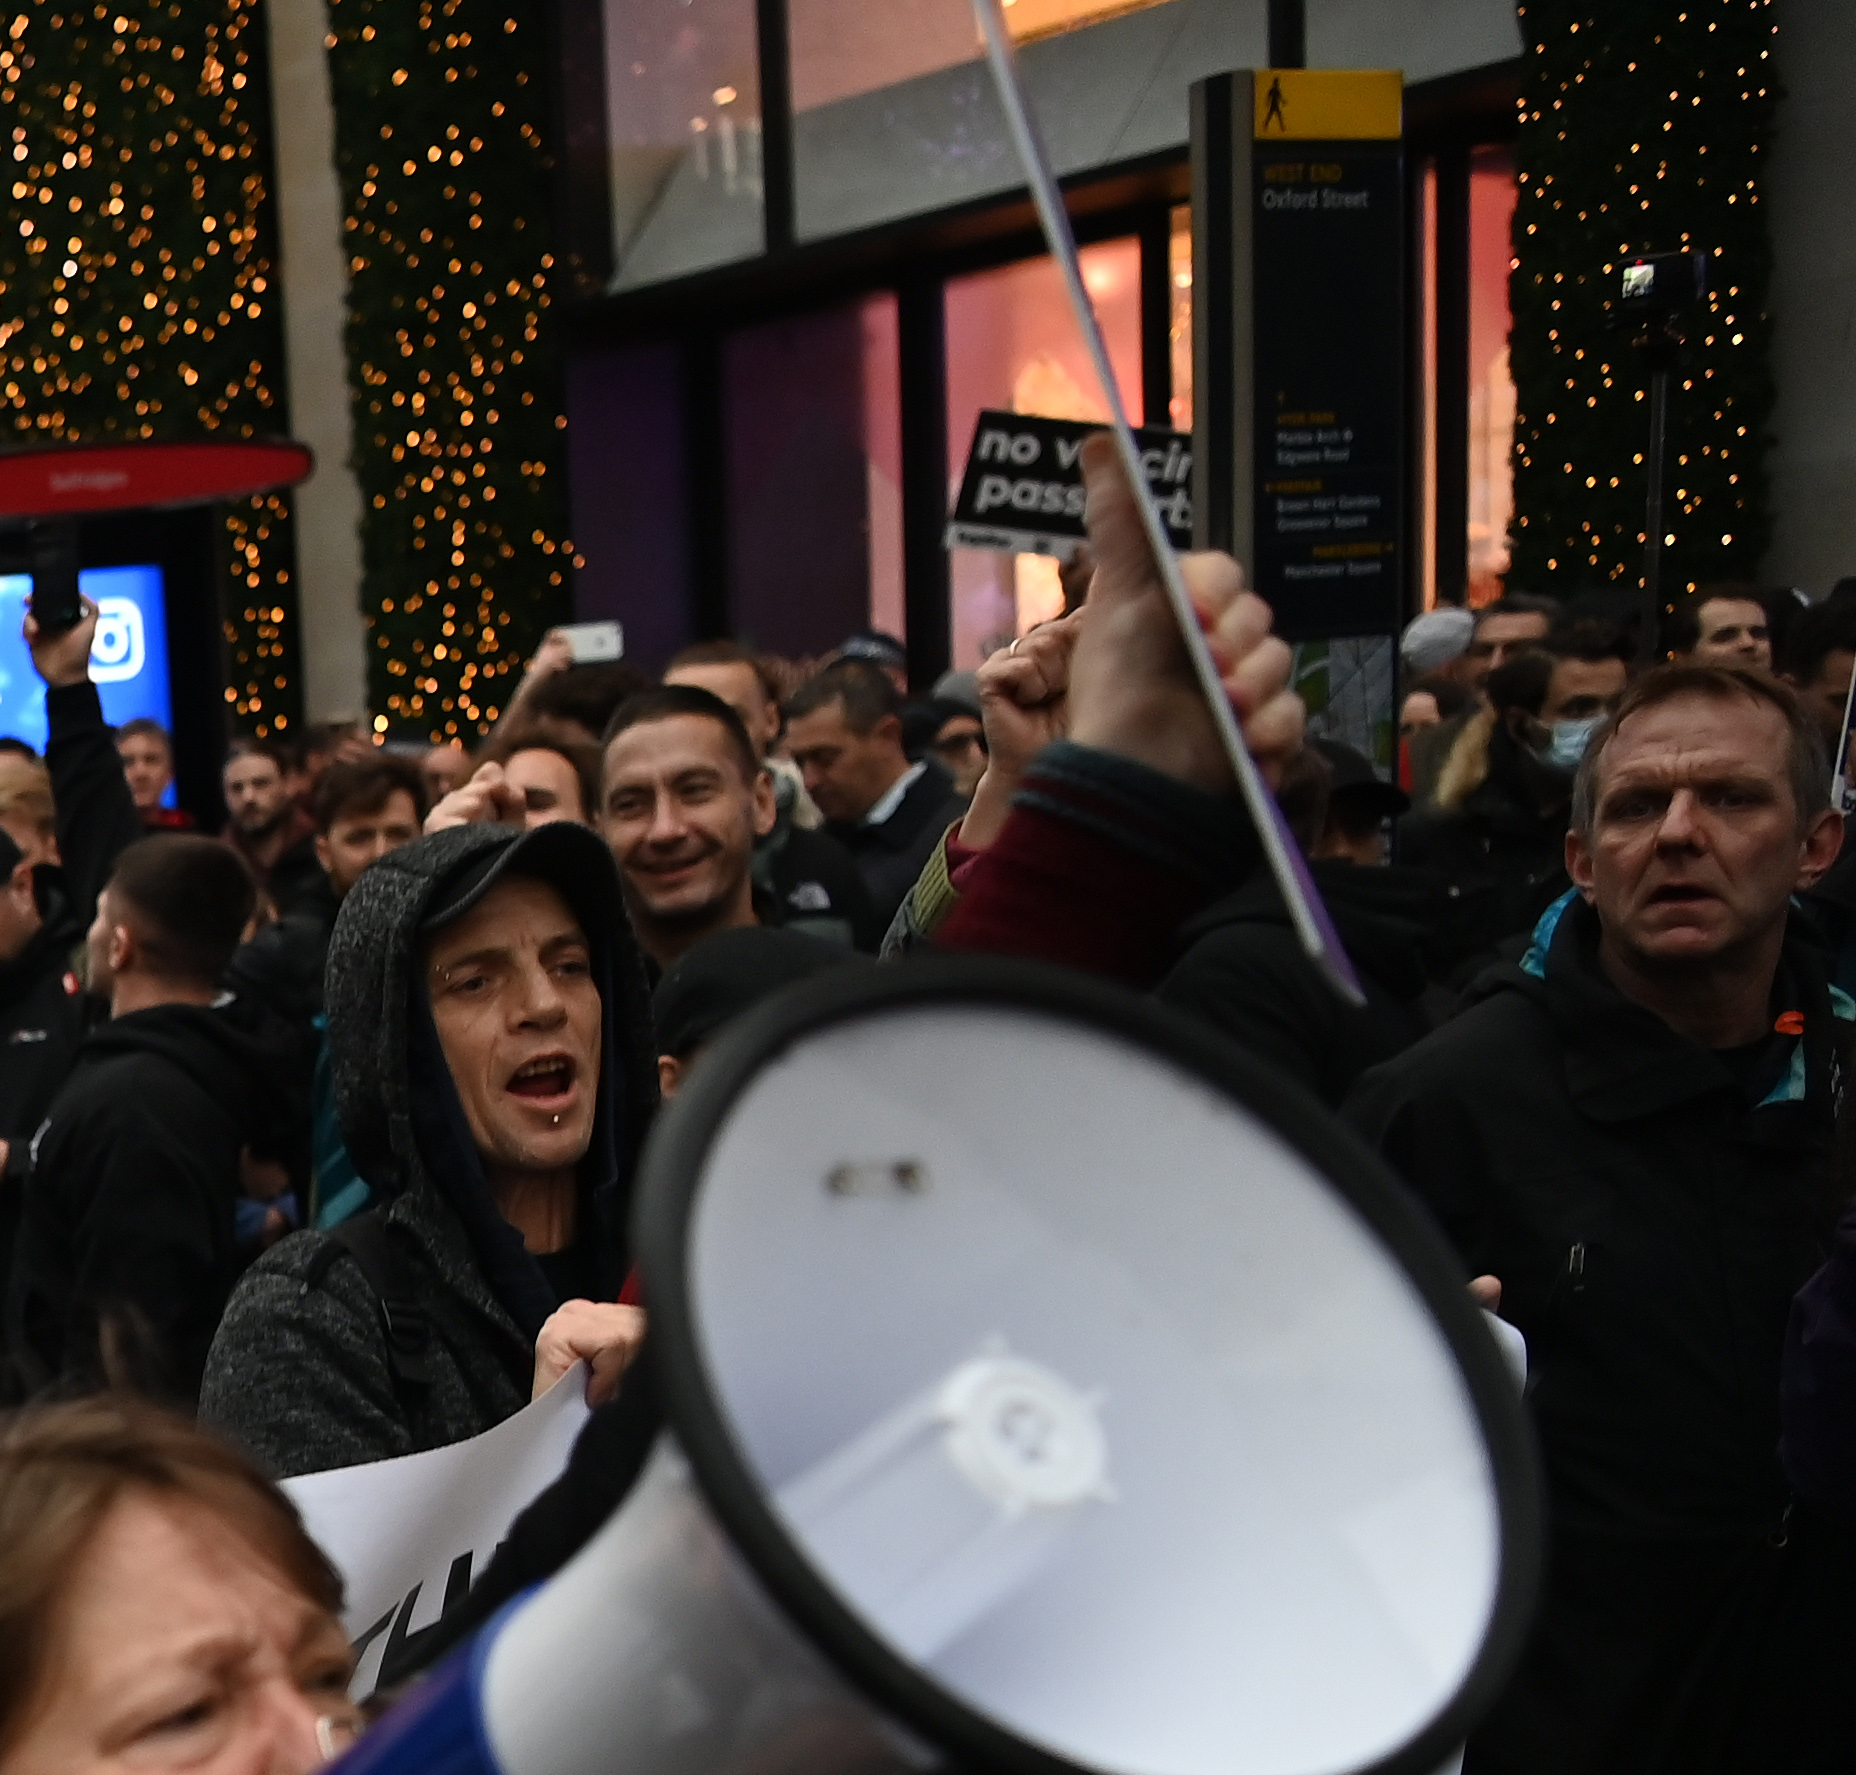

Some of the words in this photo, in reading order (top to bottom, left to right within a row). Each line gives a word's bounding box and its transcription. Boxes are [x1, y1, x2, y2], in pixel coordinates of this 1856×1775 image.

[1263, 188, 1318, 210] Oxford
[1322, 188, 1369, 208] Street
[977, 428, 1042, 466] no
